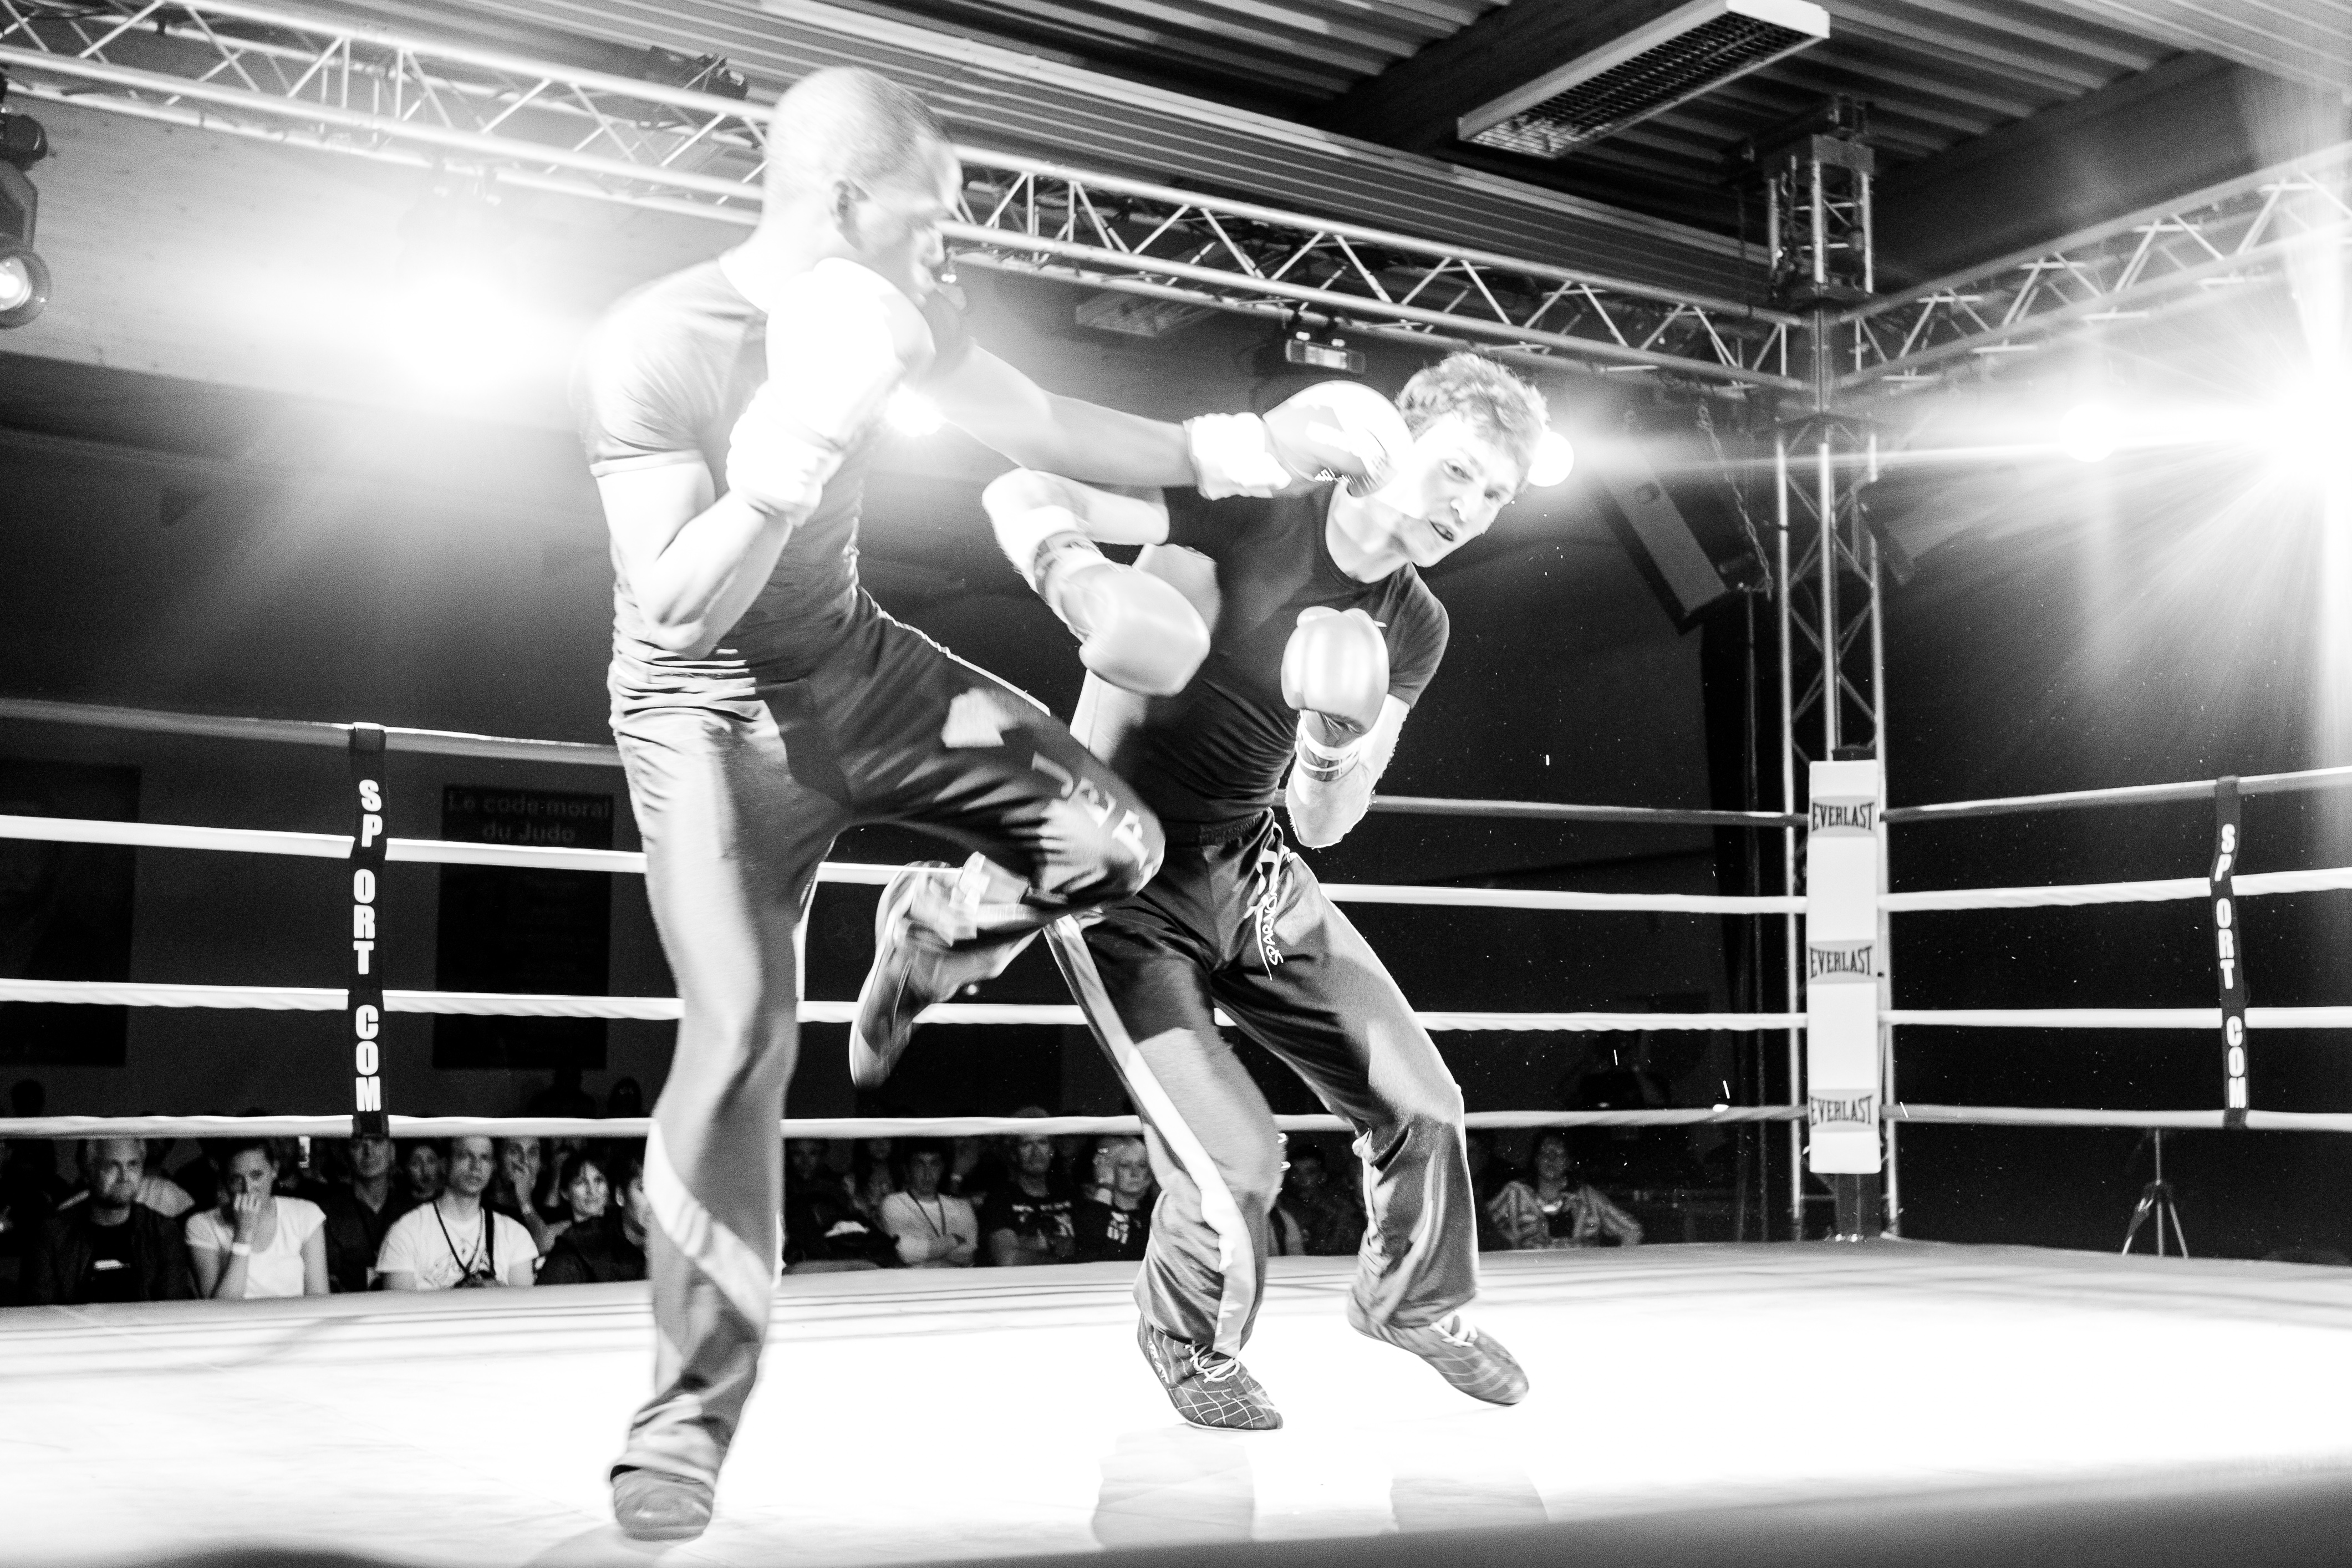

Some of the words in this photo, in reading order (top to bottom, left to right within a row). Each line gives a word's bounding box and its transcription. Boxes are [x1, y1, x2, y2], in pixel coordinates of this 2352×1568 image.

[449, 789, 476, 813] Le
[483, 795, 539, 816] code
[546, 798, 609, 819] moral
[1812, 802, 1875, 831] EVERLAST
[482, 822, 511, 842] du
[518, 822, 576, 843] Judo
[1810, 946, 1873, 979] EVERLAST
[355, 1005, 381, 1112] COM
[2226, 1016, 2247, 1108] COM
[1809, 1094, 1873, 1127] EVERLAST
